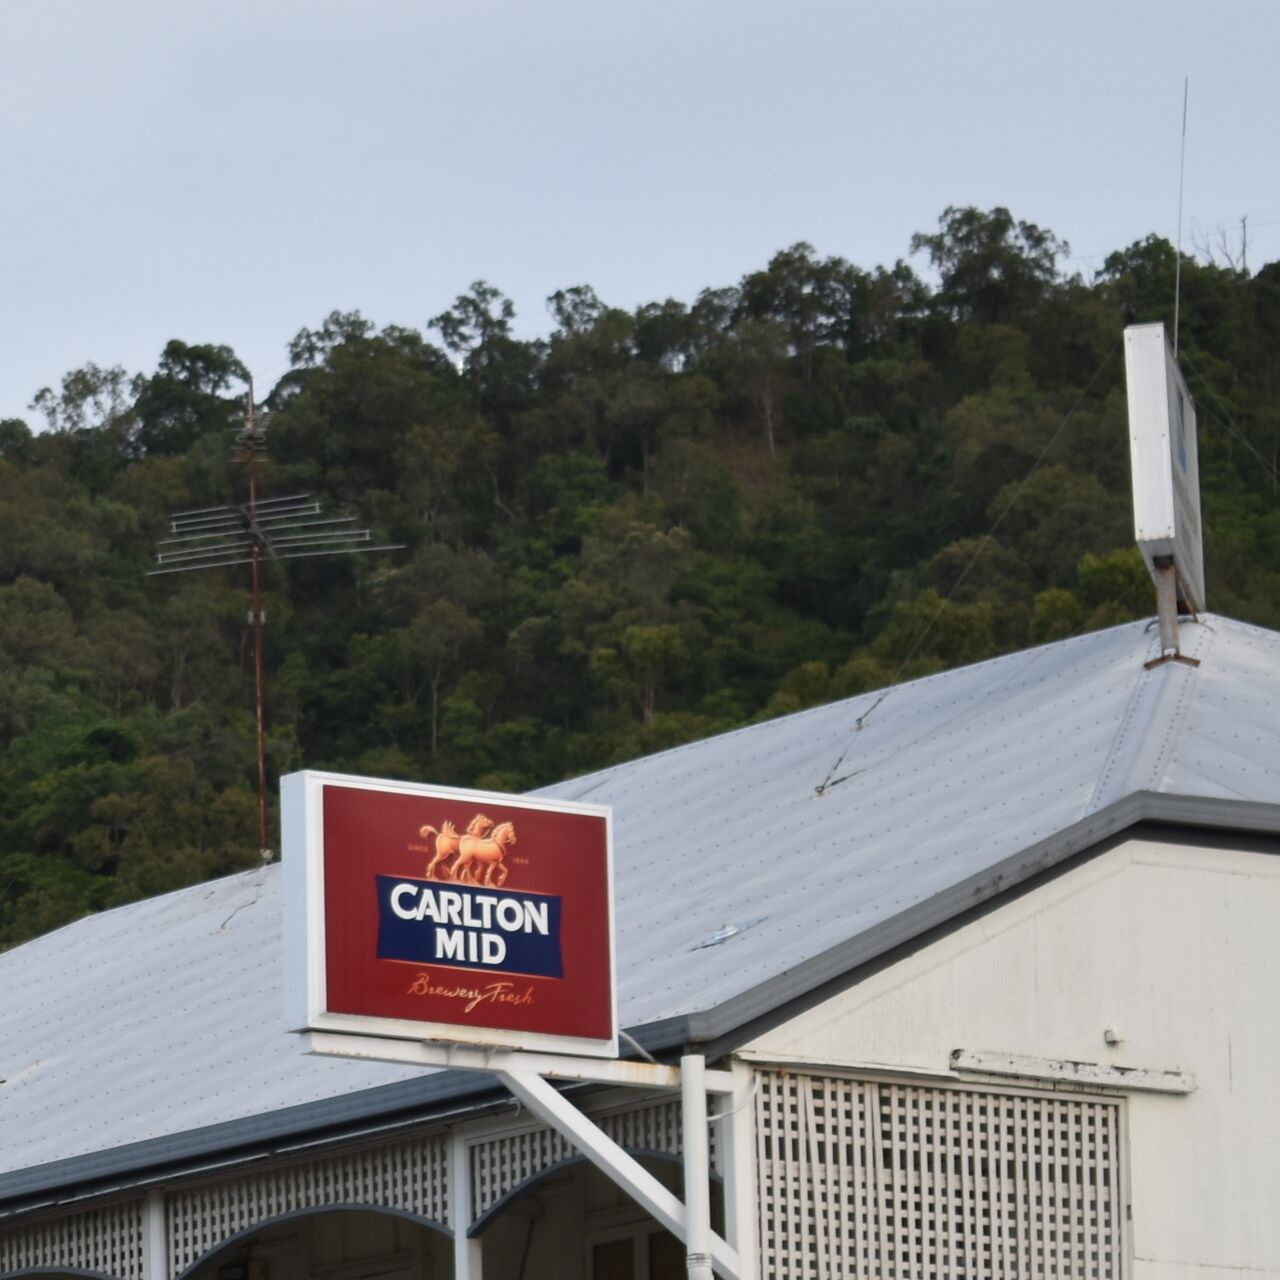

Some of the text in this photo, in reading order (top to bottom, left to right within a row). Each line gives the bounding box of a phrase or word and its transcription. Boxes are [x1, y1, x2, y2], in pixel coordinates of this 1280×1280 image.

[390, 883, 550, 936] CARLTON
[435, 928, 507, 965] MID
[407, 973, 536, 1013] Brewery Fresh
